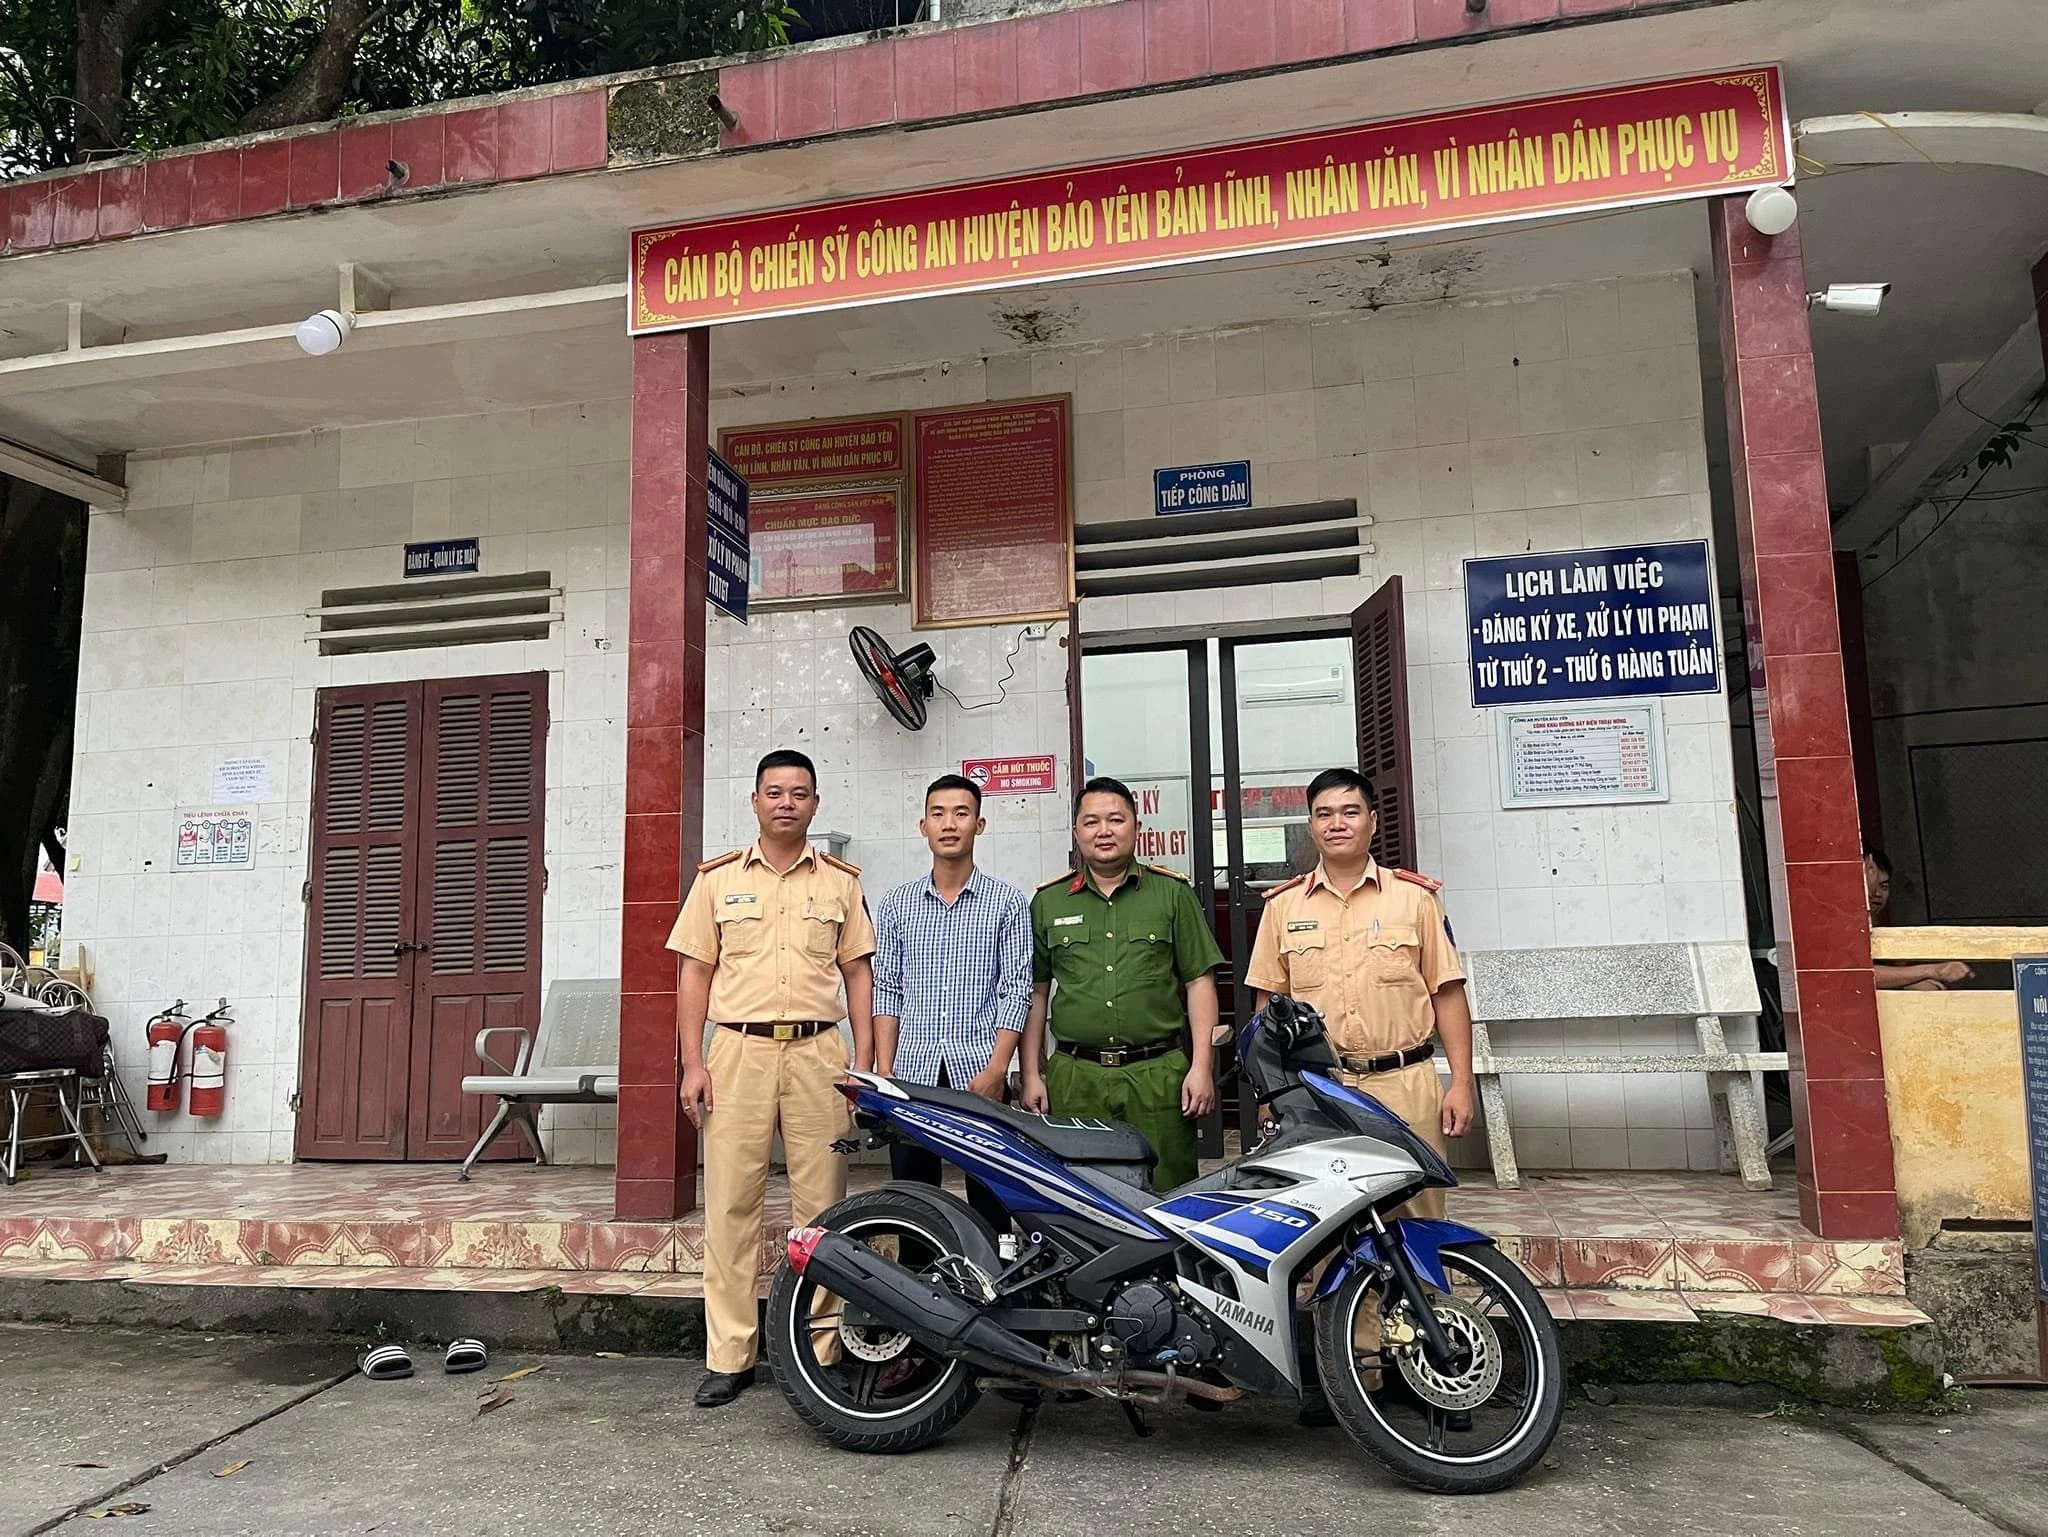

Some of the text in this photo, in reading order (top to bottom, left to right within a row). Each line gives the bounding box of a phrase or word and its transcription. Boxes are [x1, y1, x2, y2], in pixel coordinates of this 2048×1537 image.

[665, 108, 1740, 306] CÁN BỘ CHIẾN SỸ CÔNG AN HUYỆN BẢO YÊN BẢN LĨNH, NHÂN VĂN, VÌ NHÂN DÂN PHỤC VỤ
[822, 437, 833, 449] AN
[1180, 469, 1226, 481] PHÒNG
[1161, 480, 1246, 507] TIẾP CÔNG DÂN
[1506, 558, 1664, 601] LỊCH LÀM VIỆC
[1482, 613, 1527, 644] ĐĂNG
[1531, 609, 1551, 641] KÝ
[1556, 613, 1582, 641] XE,
[1586, 601, 1609, 638] XỬ
[1614, 604, 1632, 635] LÝ
[1637, 608, 1654, 634] VI
[1658, 604, 1709, 636] PHẠM
[1478, 656, 1499, 688] TỪ
[1502, 653, 1534, 687] THỨ
[1537, 659, 1548, 685] 2
[1565, 648, 1598, 682] THỨ
[1602, 655, 1612, 681] 6
[1617, 648, 1664, 679] HÀNG
[1667, 639, 1714, 676] TUẦN
[992, 759, 1050, 774] CẤM HÚT THUỐC
[1000, 777, 1041, 788] NO SMOKING
[1143, 785, 1160, 814] KÝ
[1137, 827, 1186, 861] TIỆN GT
[893, 1107, 1006, 1151] EXCITER GP
[1249, 1205, 1308, 1228] 150
[1215, 1296, 1275, 1336] YAMAHA
